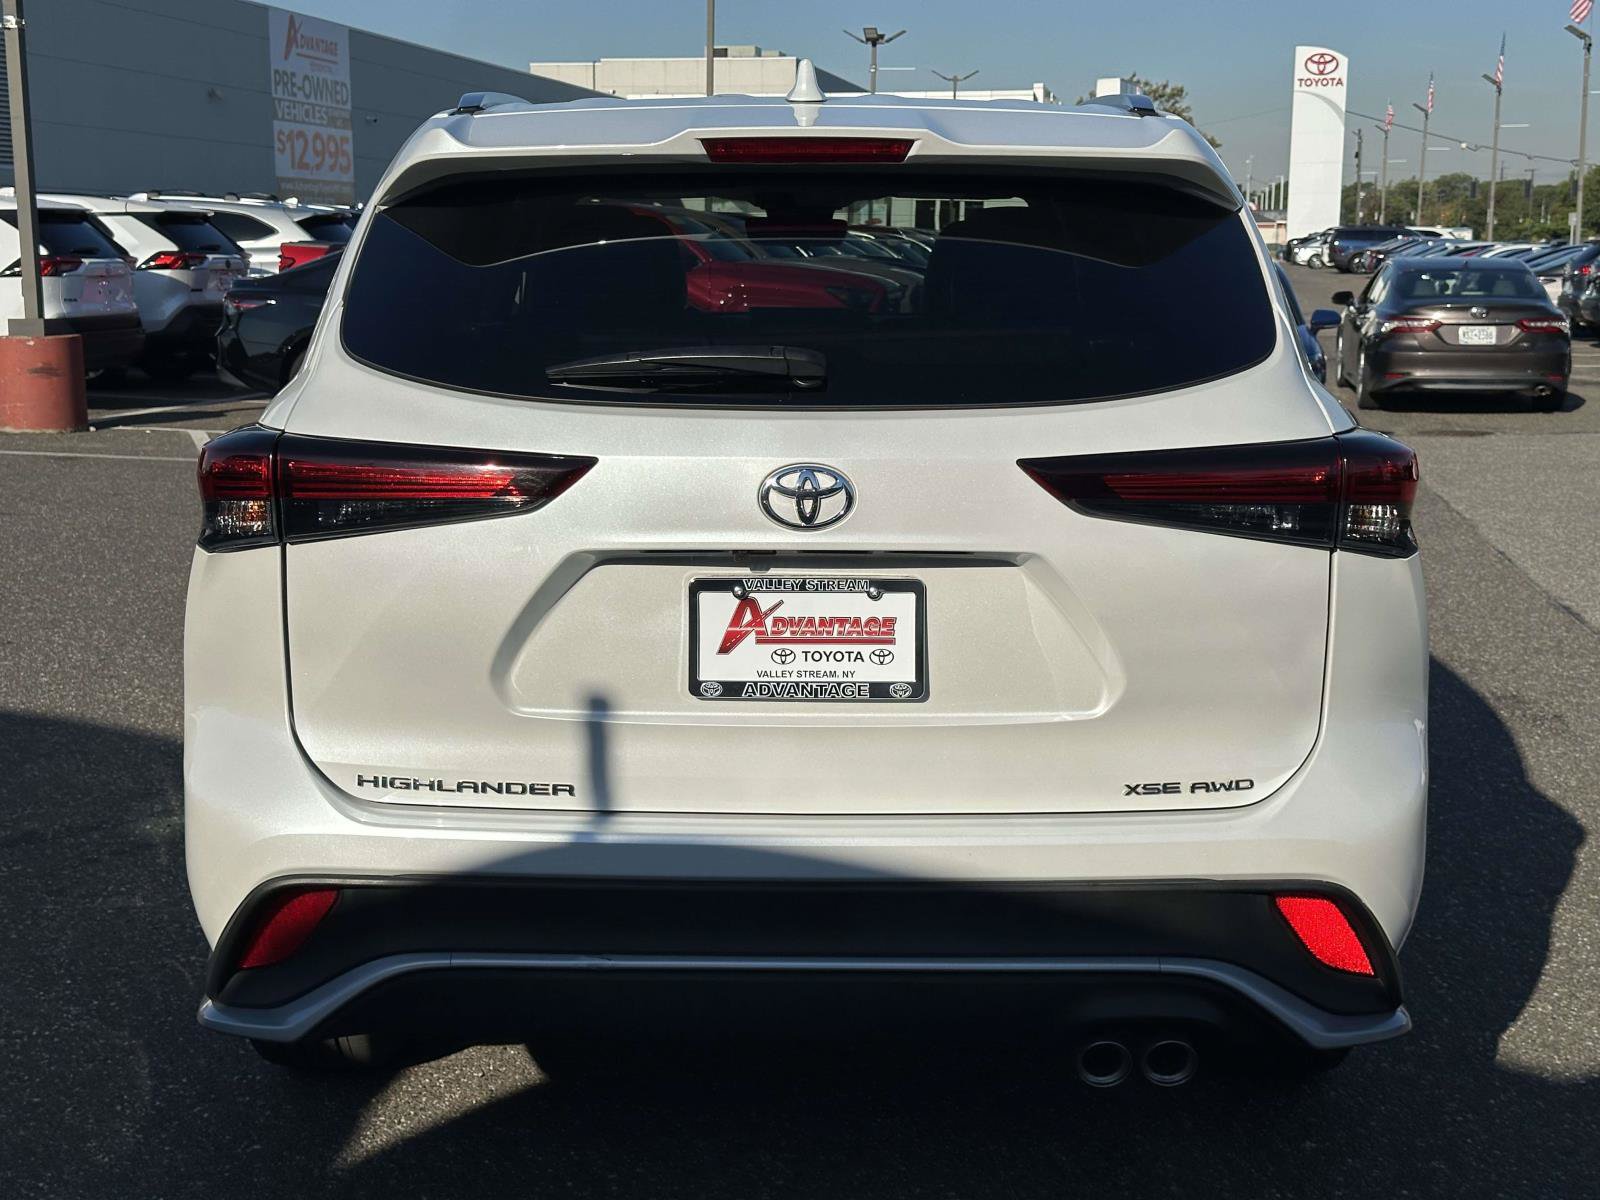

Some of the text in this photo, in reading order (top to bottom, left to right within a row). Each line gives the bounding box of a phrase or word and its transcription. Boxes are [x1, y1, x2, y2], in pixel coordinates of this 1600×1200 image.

[273, 69, 350, 106] PRE-OWNED
[1297, 78, 1344, 87] TOYOTA
[275, 101, 328, 125] VEHICLES
[276, 127, 352, 176] $12,995
[743, 579, 870, 591] VALLEY STREAM
[716, 597, 897, 655] ADVANTAGE
[802, 651, 864, 662] TOYOTA
[757, 670, 793, 678] VALLEY
[842, 670, 856, 678] NY
[743, 683, 870, 699] ADVANTAGE
[357, 774, 576, 797] HIGHLANDER
[1124, 779, 1254, 796] XSE AWD
